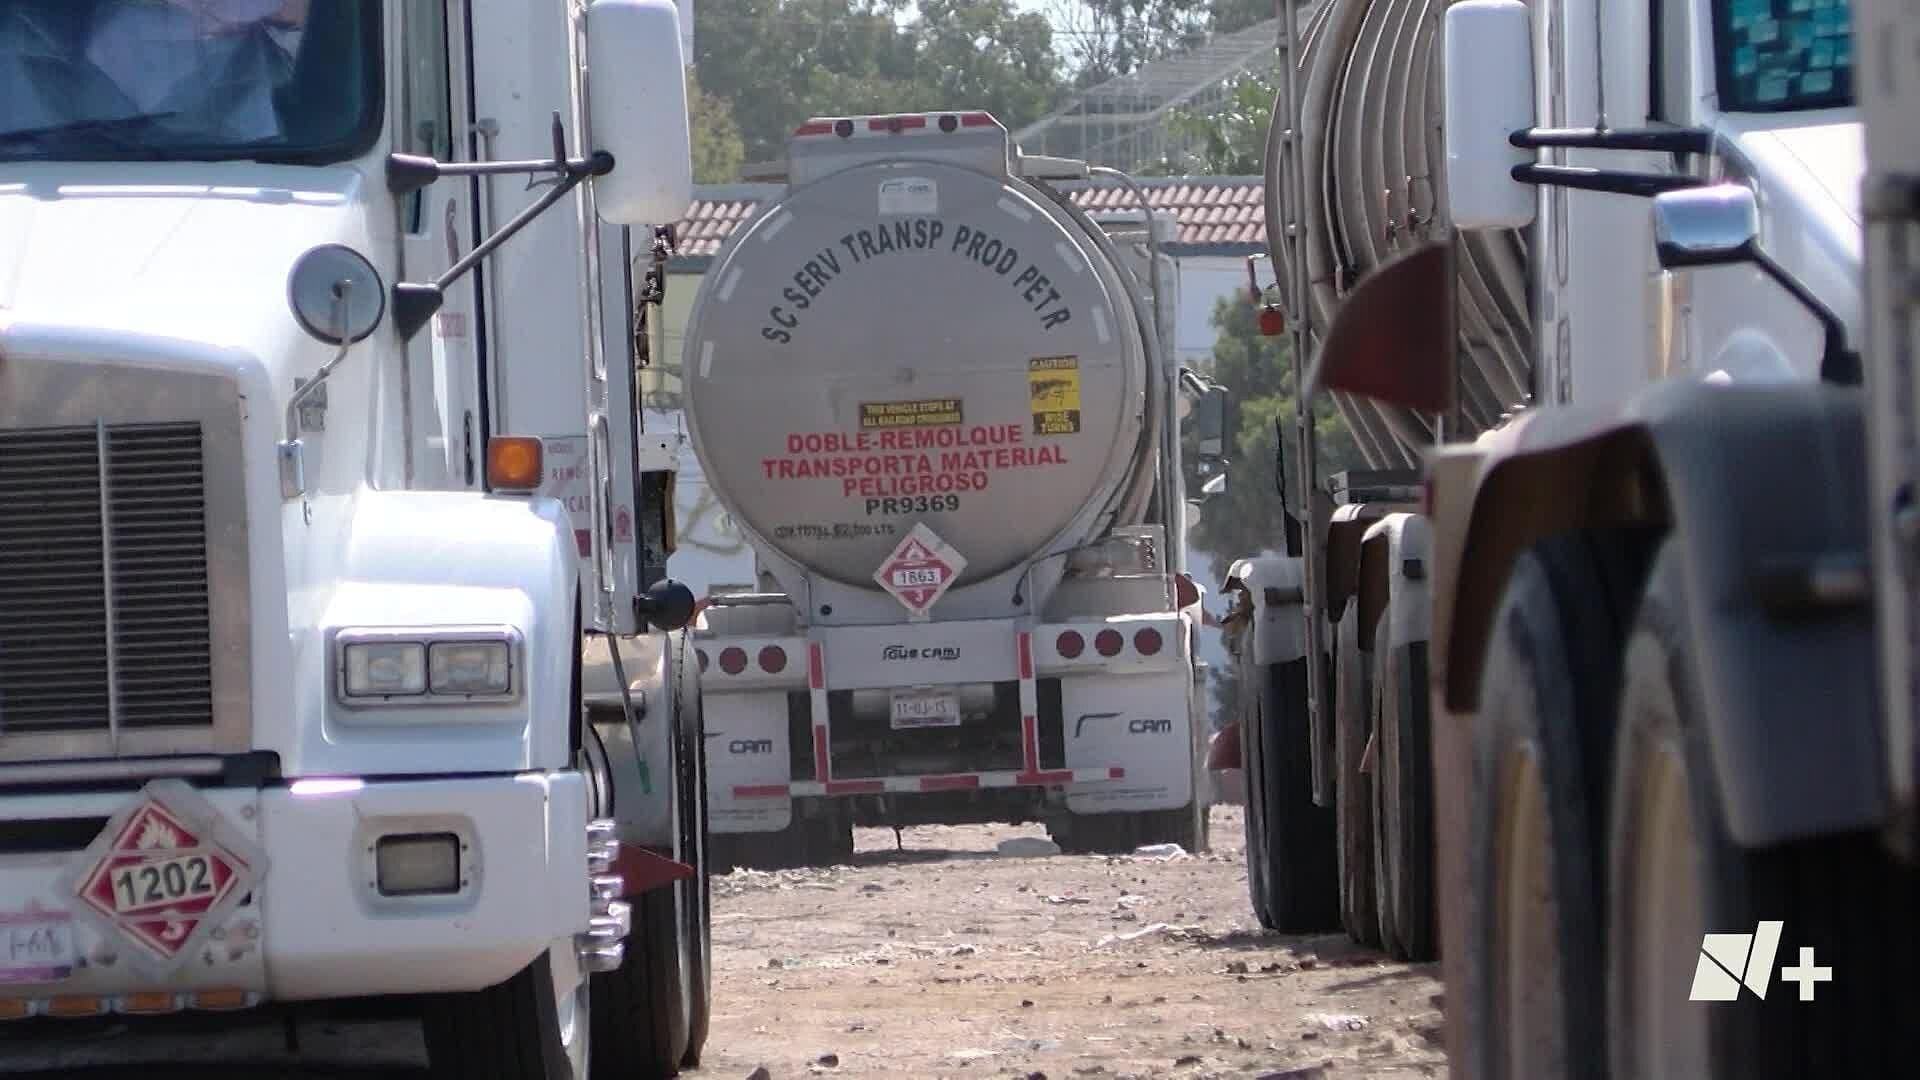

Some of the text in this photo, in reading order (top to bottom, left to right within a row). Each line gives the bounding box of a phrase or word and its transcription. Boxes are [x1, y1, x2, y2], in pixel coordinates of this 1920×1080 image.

[783, 247, 841, 309] SERV
[840, 218, 944, 263] TRANSP
[951, 223, 1018, 275] PROD
[1012, 264, 1071, 330] PETR
[786, 424, 1022, 454] DOBLE-REMOLQUE
[762, 445, 1067, 479] TRANSPORTA MATERIAL
[843, 470, 988, 497] PELIGROSO
[865, 494, 960, 515] PR9369
[1128, 719, 1171, 733] CAM
[728, 739, 772, 754] CAM
[117, 856, 211, 907] 1202
